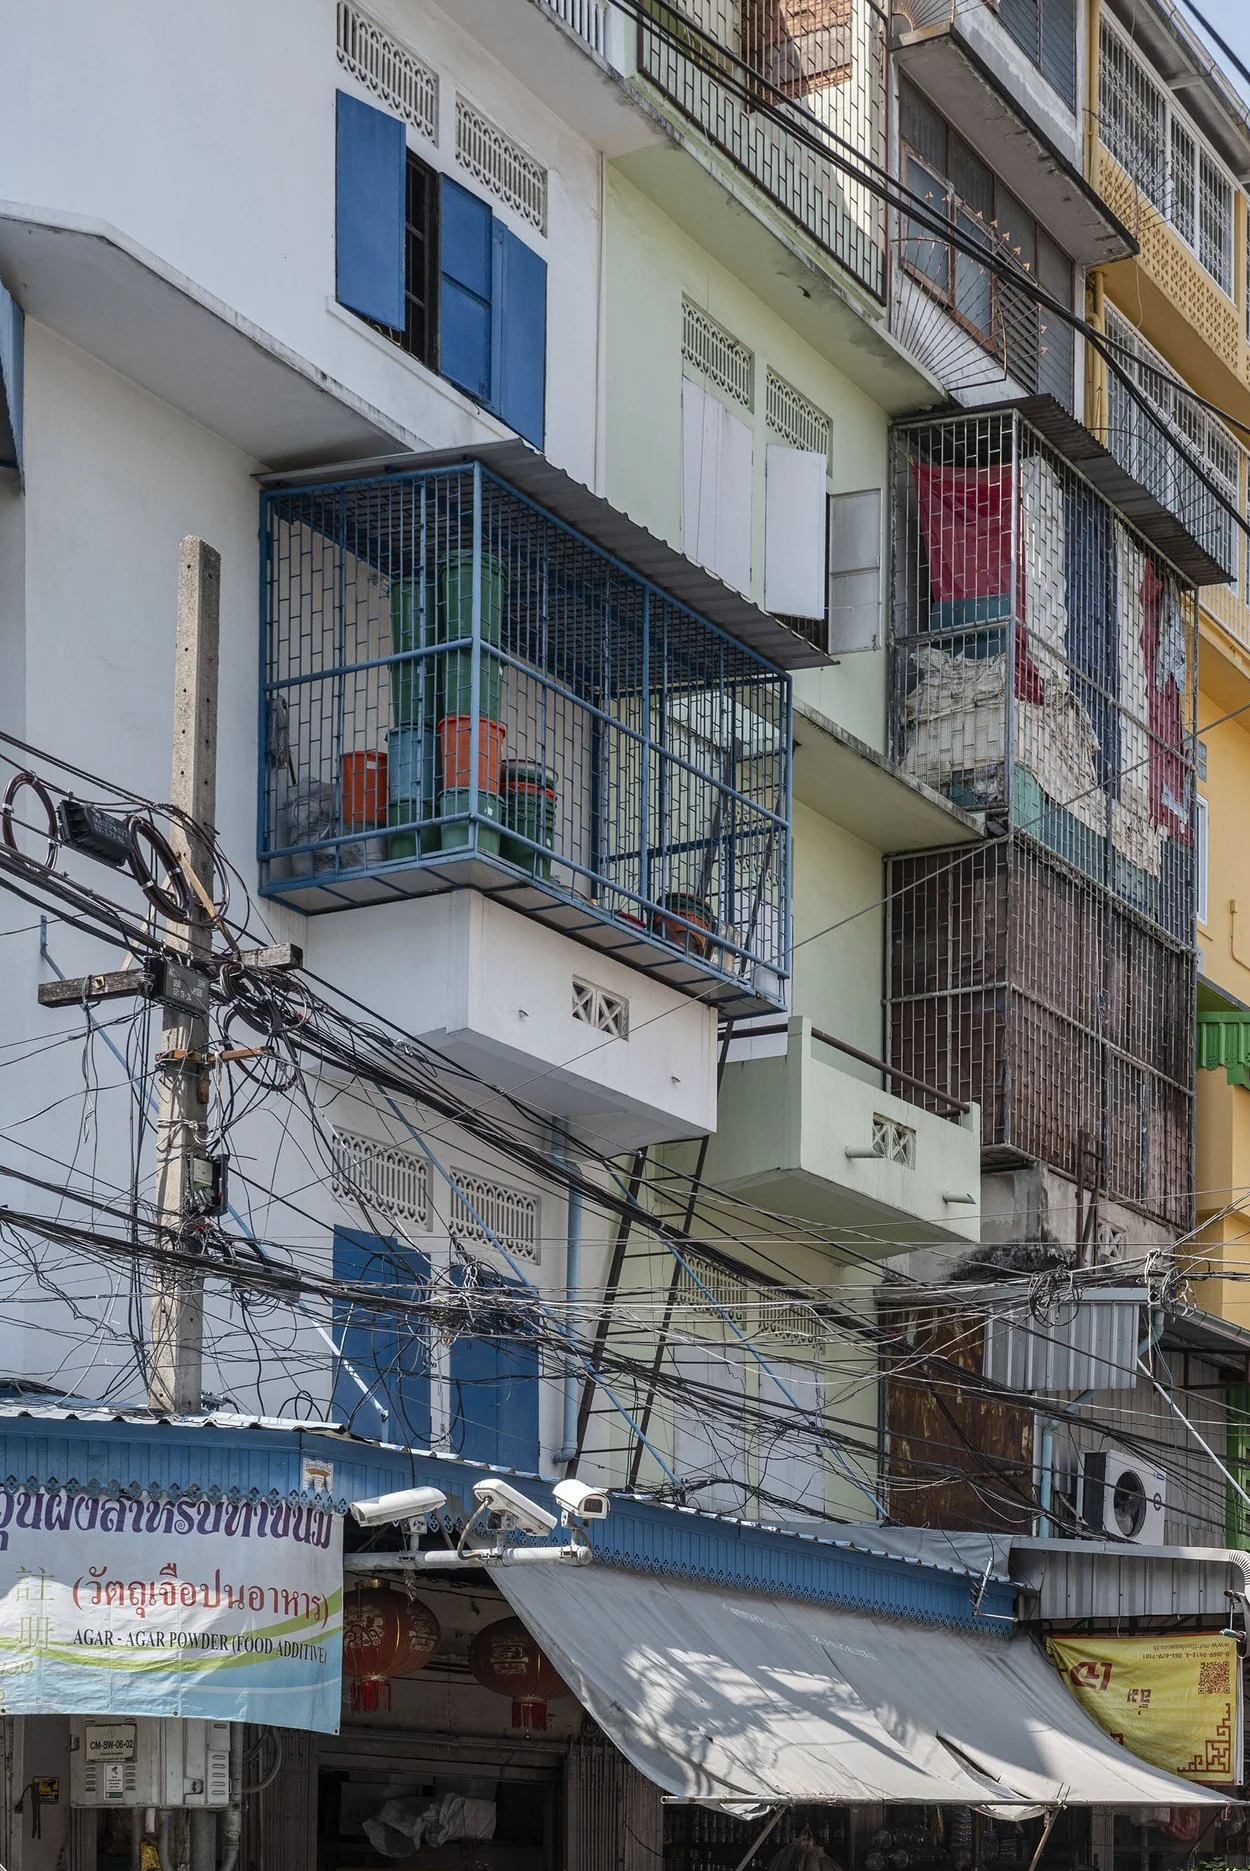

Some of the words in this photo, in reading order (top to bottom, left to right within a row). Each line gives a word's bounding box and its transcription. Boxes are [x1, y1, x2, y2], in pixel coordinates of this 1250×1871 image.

[72, 1562, 329, 1629] (วัตถุเจือปนอาหาร)
[73, 1628, 113, 1646] AGAR
[126, 1630, 166, 1648] AGAR
[169, 1633, 229, 1651] POWDER
[231, 1635, 273, 1656] (FOOD
[274, 1640, 329, 1665] ADDITIVE)
[90, 1739, 134, 1751] CM-SW-06-02
